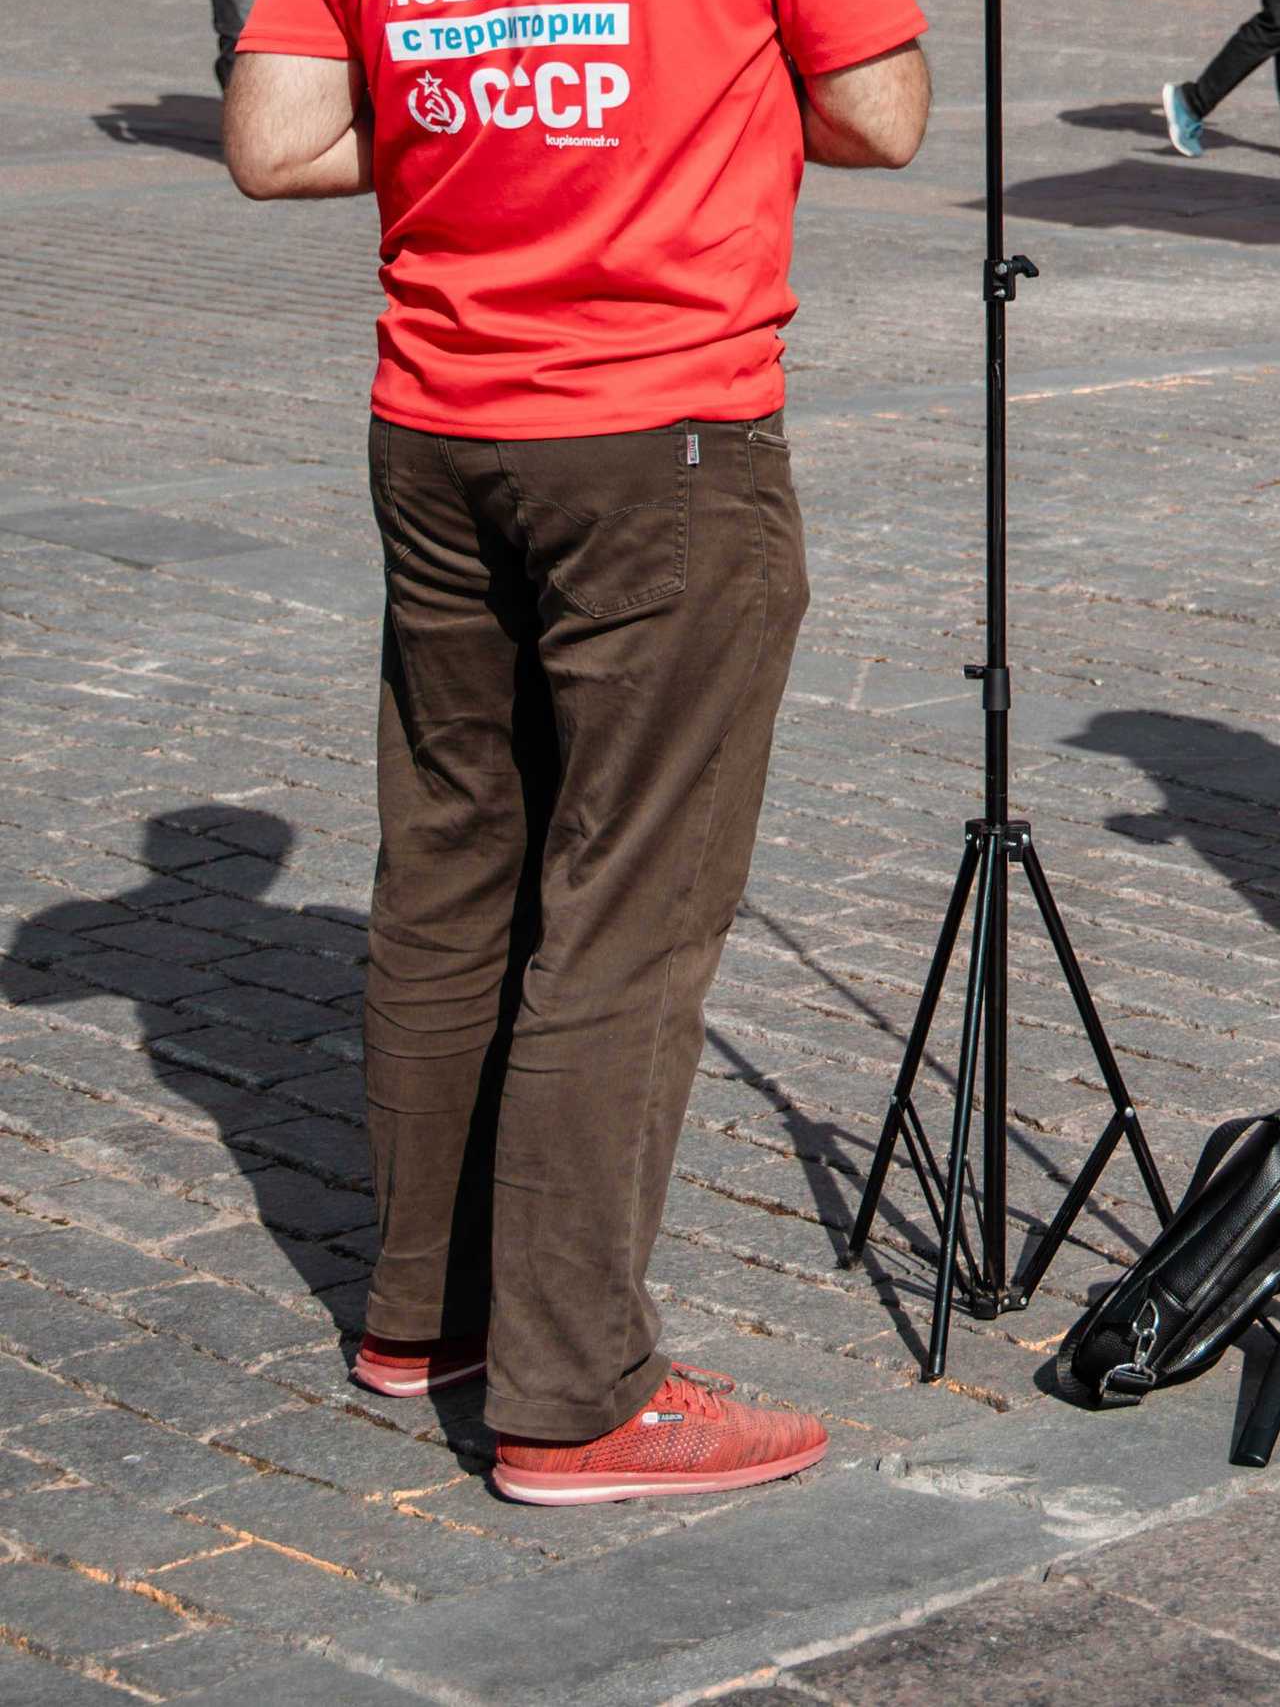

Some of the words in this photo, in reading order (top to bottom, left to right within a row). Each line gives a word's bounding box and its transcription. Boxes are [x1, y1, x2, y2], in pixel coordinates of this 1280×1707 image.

[430, 12, 616, 55] территории
[469, 61, 631, 130] СССР
[546, 134, 620, 150] kupisarmat.ru
